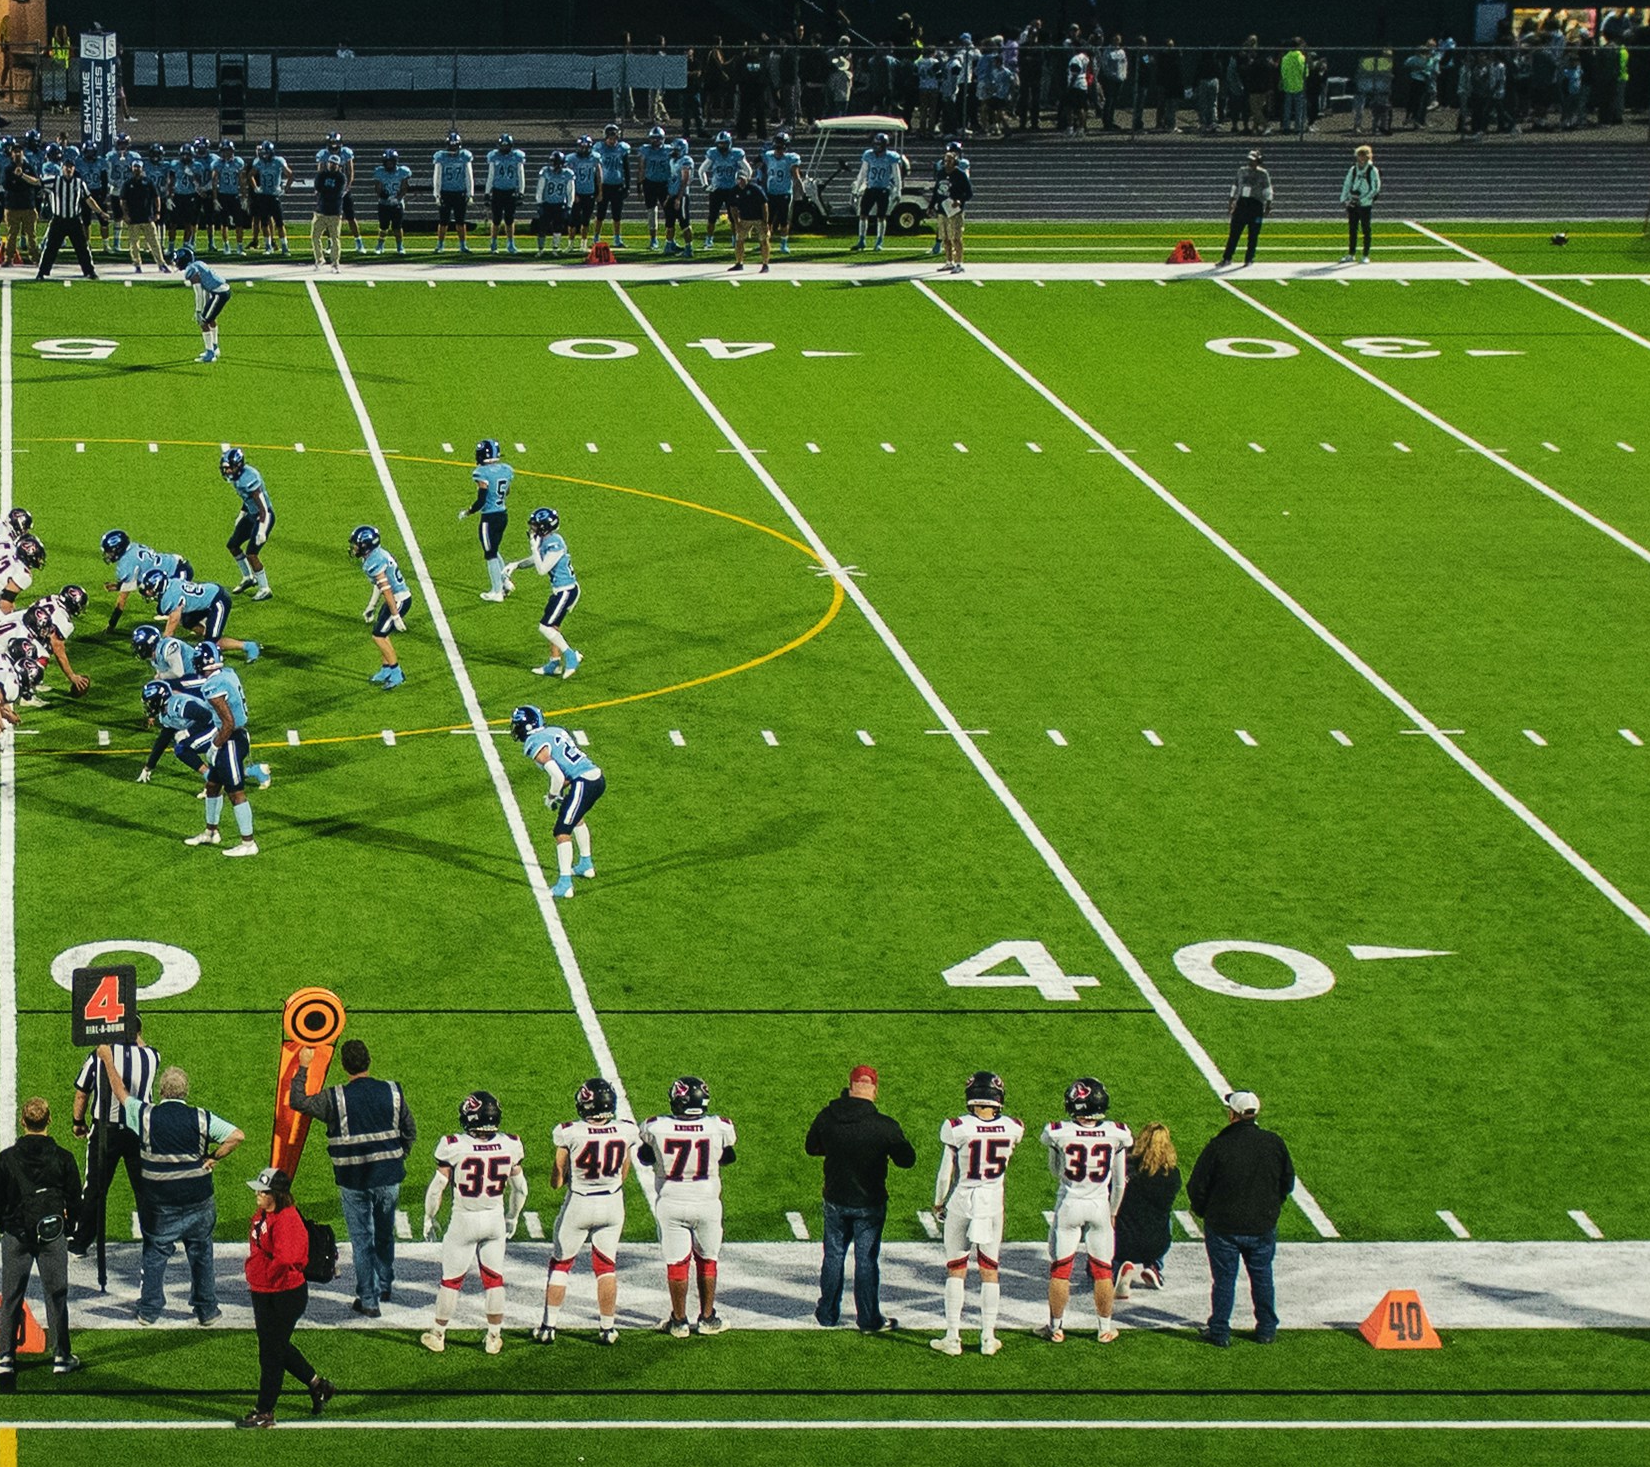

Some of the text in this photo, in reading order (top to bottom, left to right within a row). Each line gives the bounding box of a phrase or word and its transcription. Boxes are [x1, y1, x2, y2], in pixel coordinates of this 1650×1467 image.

[82, 71, 92, 135] SKYLINE
[496, 481, 508, 504] 5
[941, 940, 1336, 1001] 40
[84, 975, 125, 1023] 4
[587, 1126, 618, 1135] KNIGHTS
[674, 1124, 704, 1133] KNIGHTS
[976, 1125, 1005, 1134] KNIGHTS
[1076, 1129, 1106, 1138] KNIGHTS
[458, 1156, 511, 1199] 35
[576, 1140, 626, 1180] 40
[664, 1138, 710, 1182] 71
[967, 1138, 1010, 1181] 15
[1064, 1143, 1113, 1183] 33
[1388, 1302, 1423, 1341] 40
